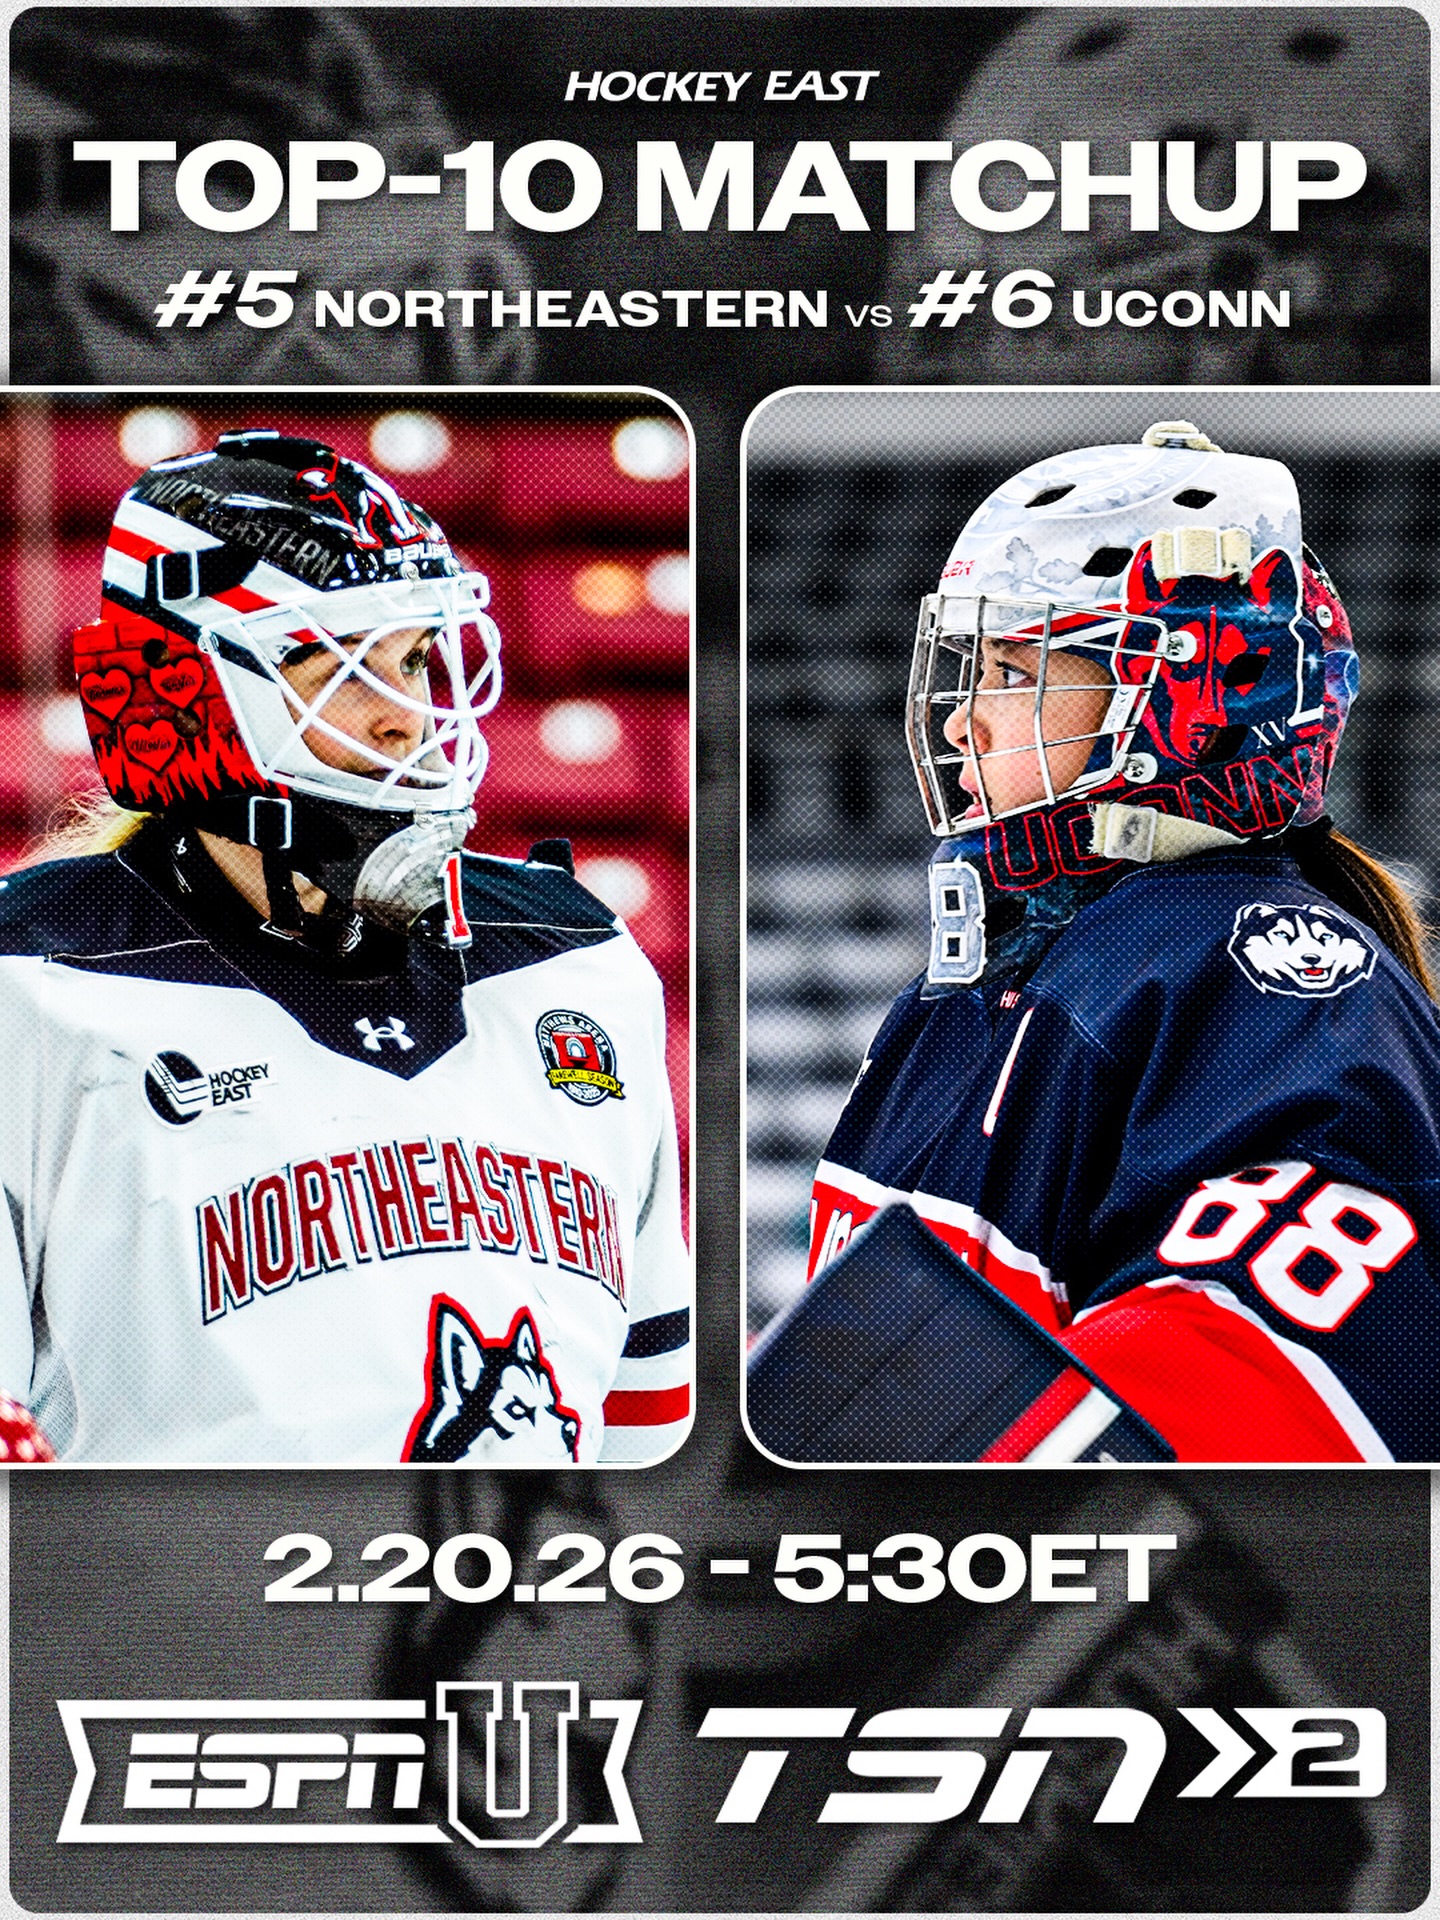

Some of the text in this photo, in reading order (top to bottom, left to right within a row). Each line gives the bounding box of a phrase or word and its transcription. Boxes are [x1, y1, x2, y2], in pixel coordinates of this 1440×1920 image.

[437, 850, 473, 950] 1
[928, 861, 986, 985] 8
[209, 1063, 268, 1089] HOCKEY
[212, 1083, 252, 1106] EAST
[197, 1135, 627, 1324] NORTHEASTERN
[1157, 1159, 1418, 1333] 88
